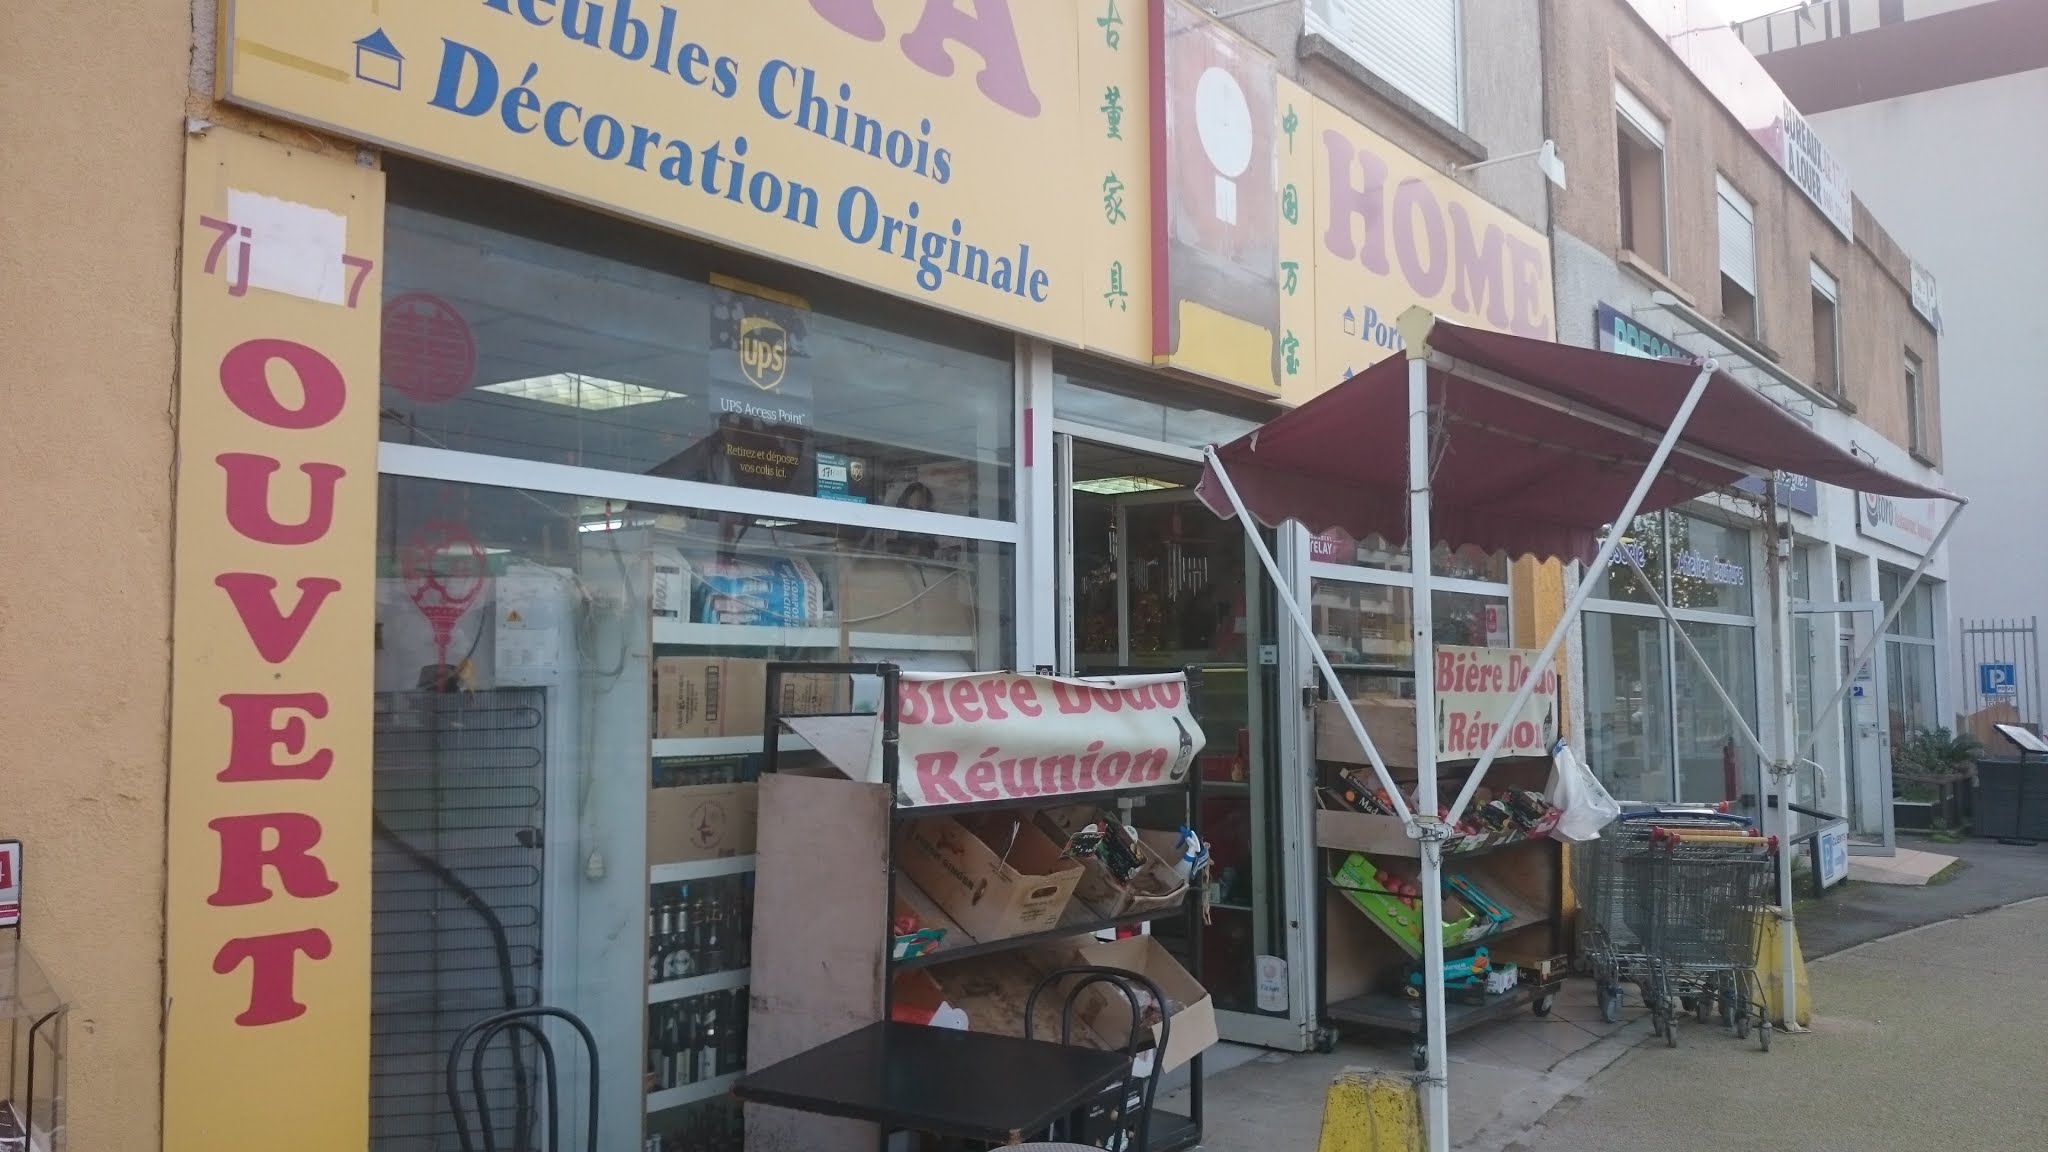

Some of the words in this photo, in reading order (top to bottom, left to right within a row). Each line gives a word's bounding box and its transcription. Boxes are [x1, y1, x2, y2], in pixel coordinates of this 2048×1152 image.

[758, 59, 952, 185] Chinois
[1783, 99, 1823, 174] BUREAUX
[427, 37, 819, 229] Décoration
[837, 185, 1050, 304] Originale
[1796, 149, 1822, 206] LOUER
[1323, 129, 1549, 341] HOME
[342, 254, 374, 309] 7
[720, 397, 743, 413] UPS
[745, 403, 777, 420] Access
[727, 444, 756, 458] Retirez
[757, 451, 765, 460] et
[766, 451, 799, 466] déposez
[740, 463, 755, 473] vos
[755, 464, 775, 476] colis
[775, 466, 787, 478] ici.
[205, 338, 347, 1028] OUVERT
[1436, 651, 1503, 693] Bière
[915, 740, 1169, 804] Réunion
